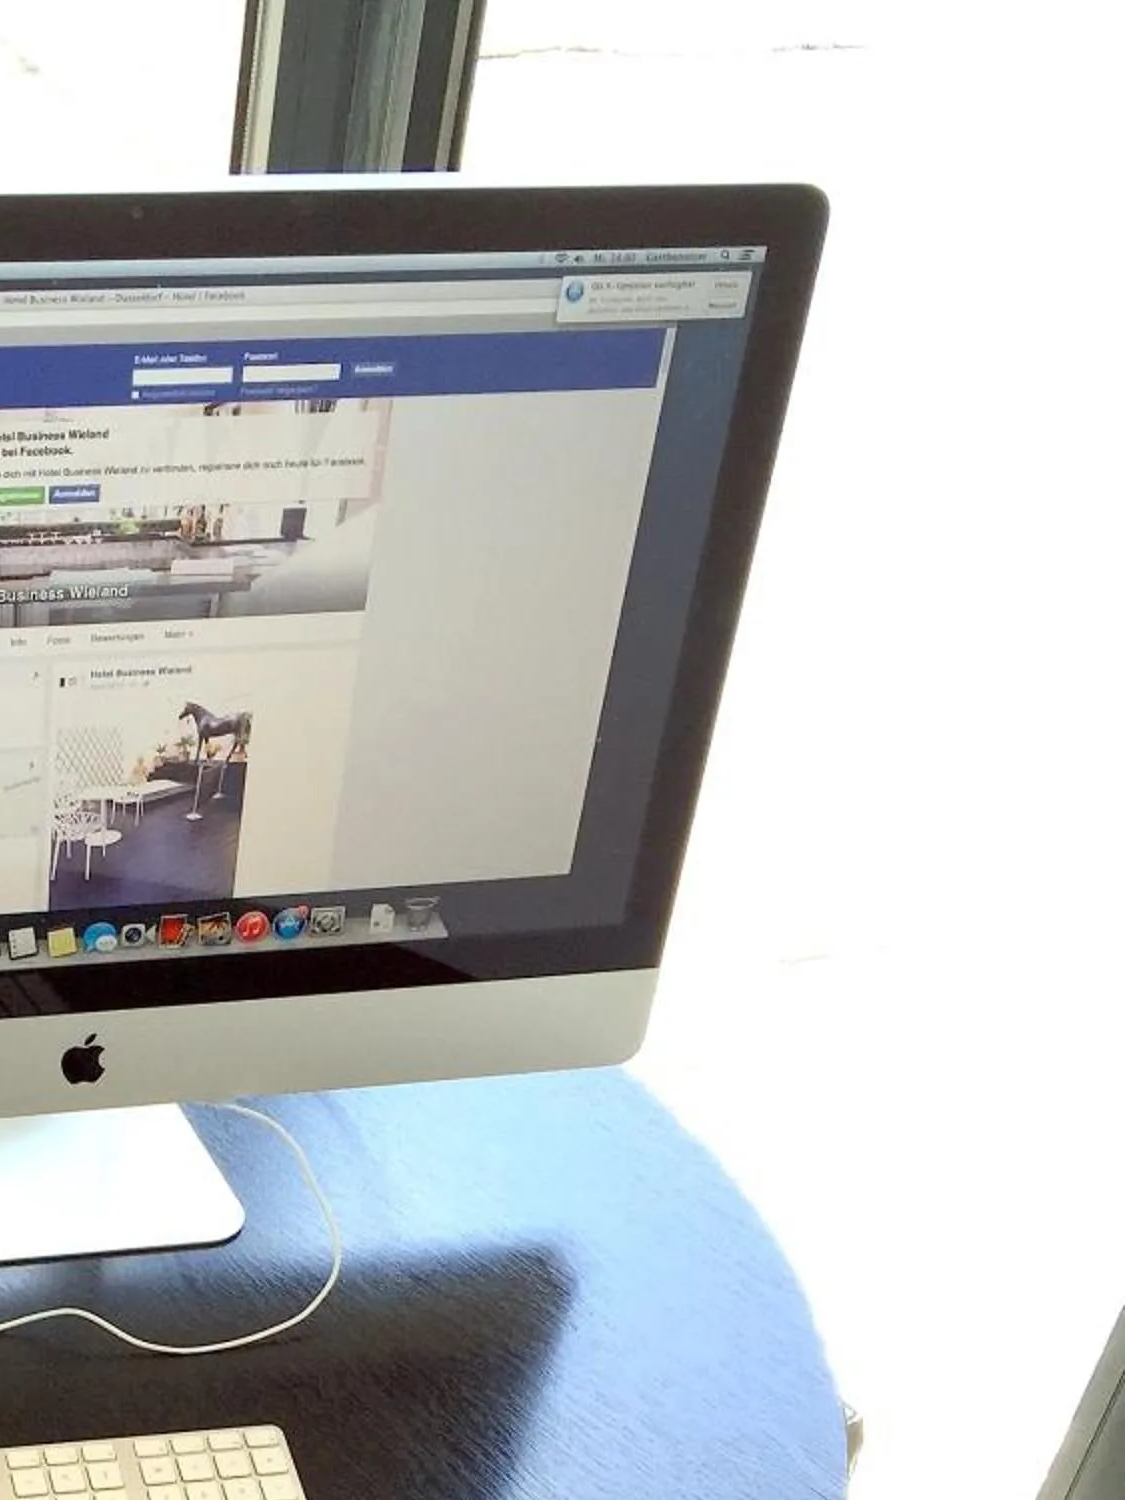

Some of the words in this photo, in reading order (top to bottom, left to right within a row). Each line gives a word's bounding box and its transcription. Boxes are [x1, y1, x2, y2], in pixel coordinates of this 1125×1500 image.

[17, 430, 66, 442] Business
[68, 428, 110, 440] Wieland
[70, 584, 129, 600] Wieland
